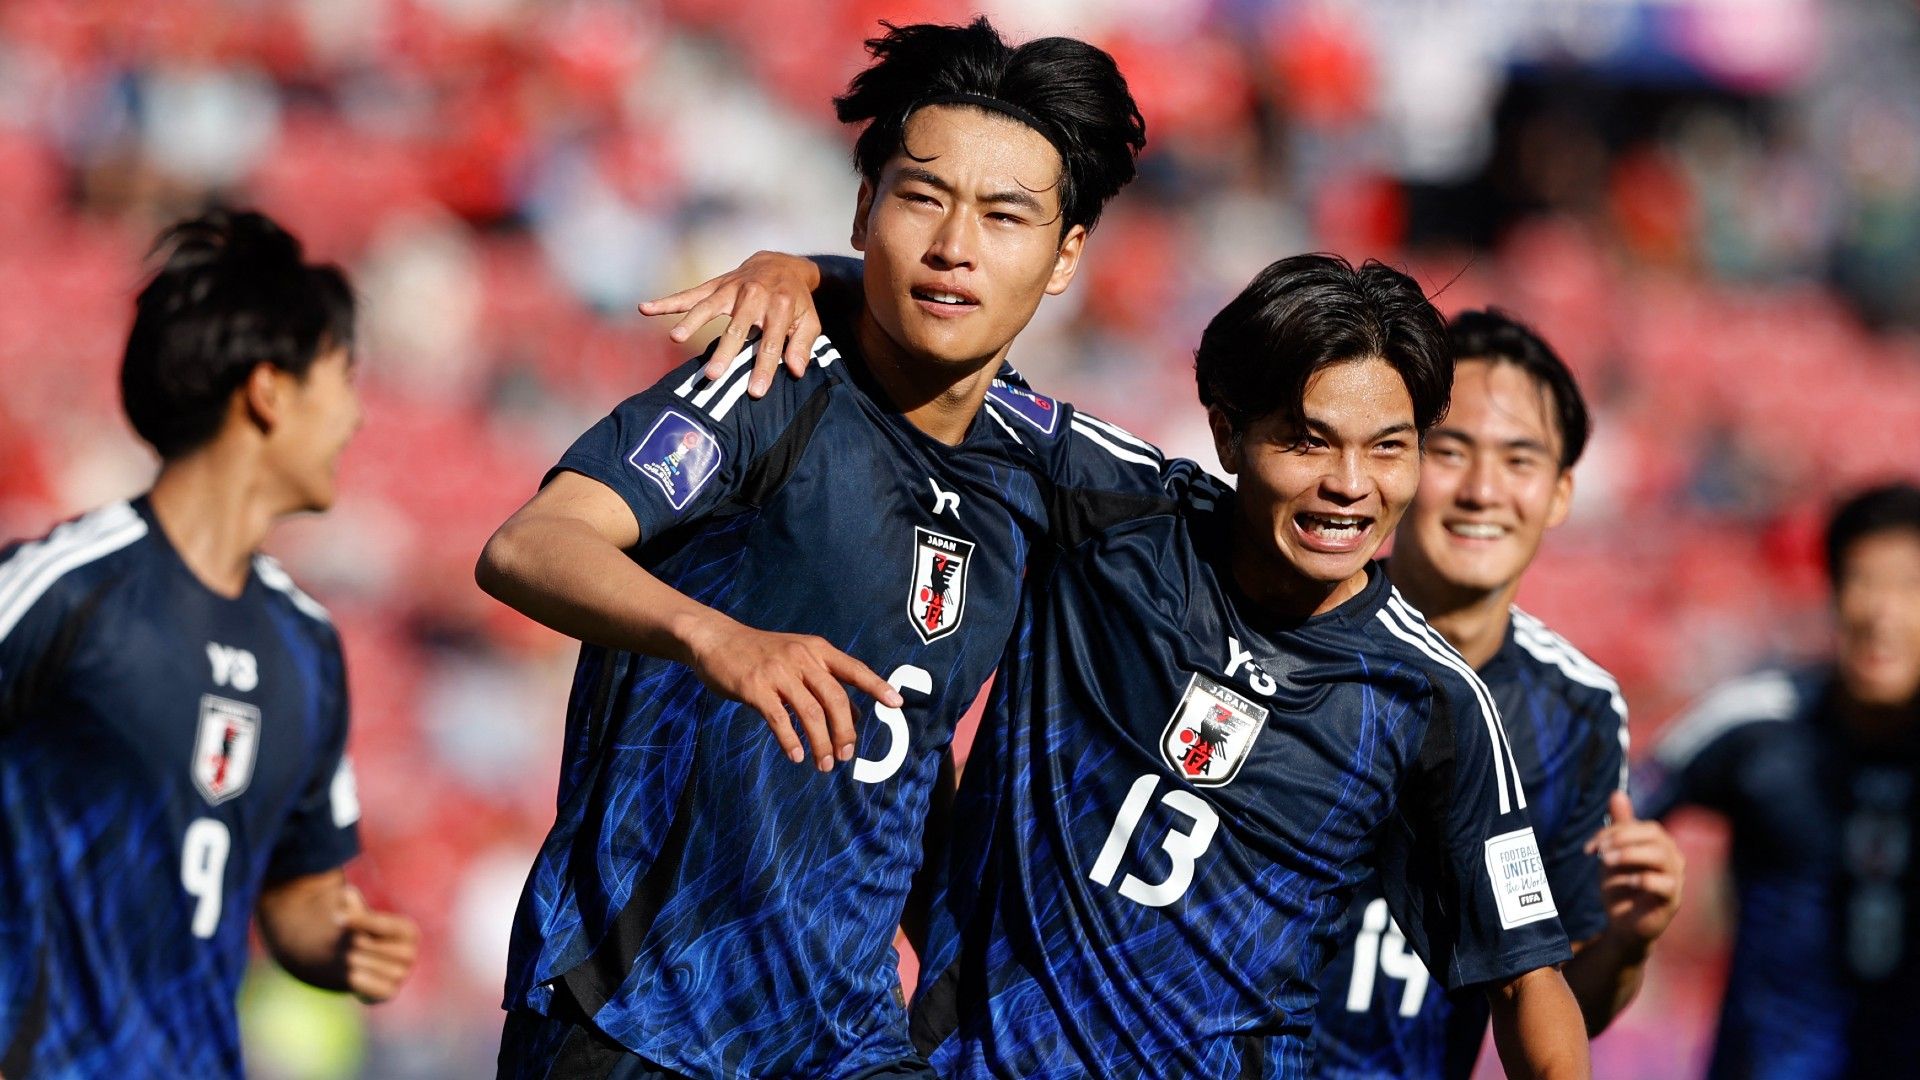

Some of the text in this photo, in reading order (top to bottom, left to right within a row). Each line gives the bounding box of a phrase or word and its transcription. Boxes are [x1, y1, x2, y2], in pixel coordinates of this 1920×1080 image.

[927, 535, 957, 552] JAPAN
[921, 605, 944, 626] JFA
[1209, 686, 1249, 713] JAPAN
[853, 664, 933, 784] 5
[1177, 747, 1212, 776] JFA
[1089, 774, 1220, 907] 13
[181, 817, 231, 939] 9
[1503, 856, 1543, 880] UNITES
[1521, 894, 1541, 906] FIFA
[1346, 897, 1431, 1017] 14
